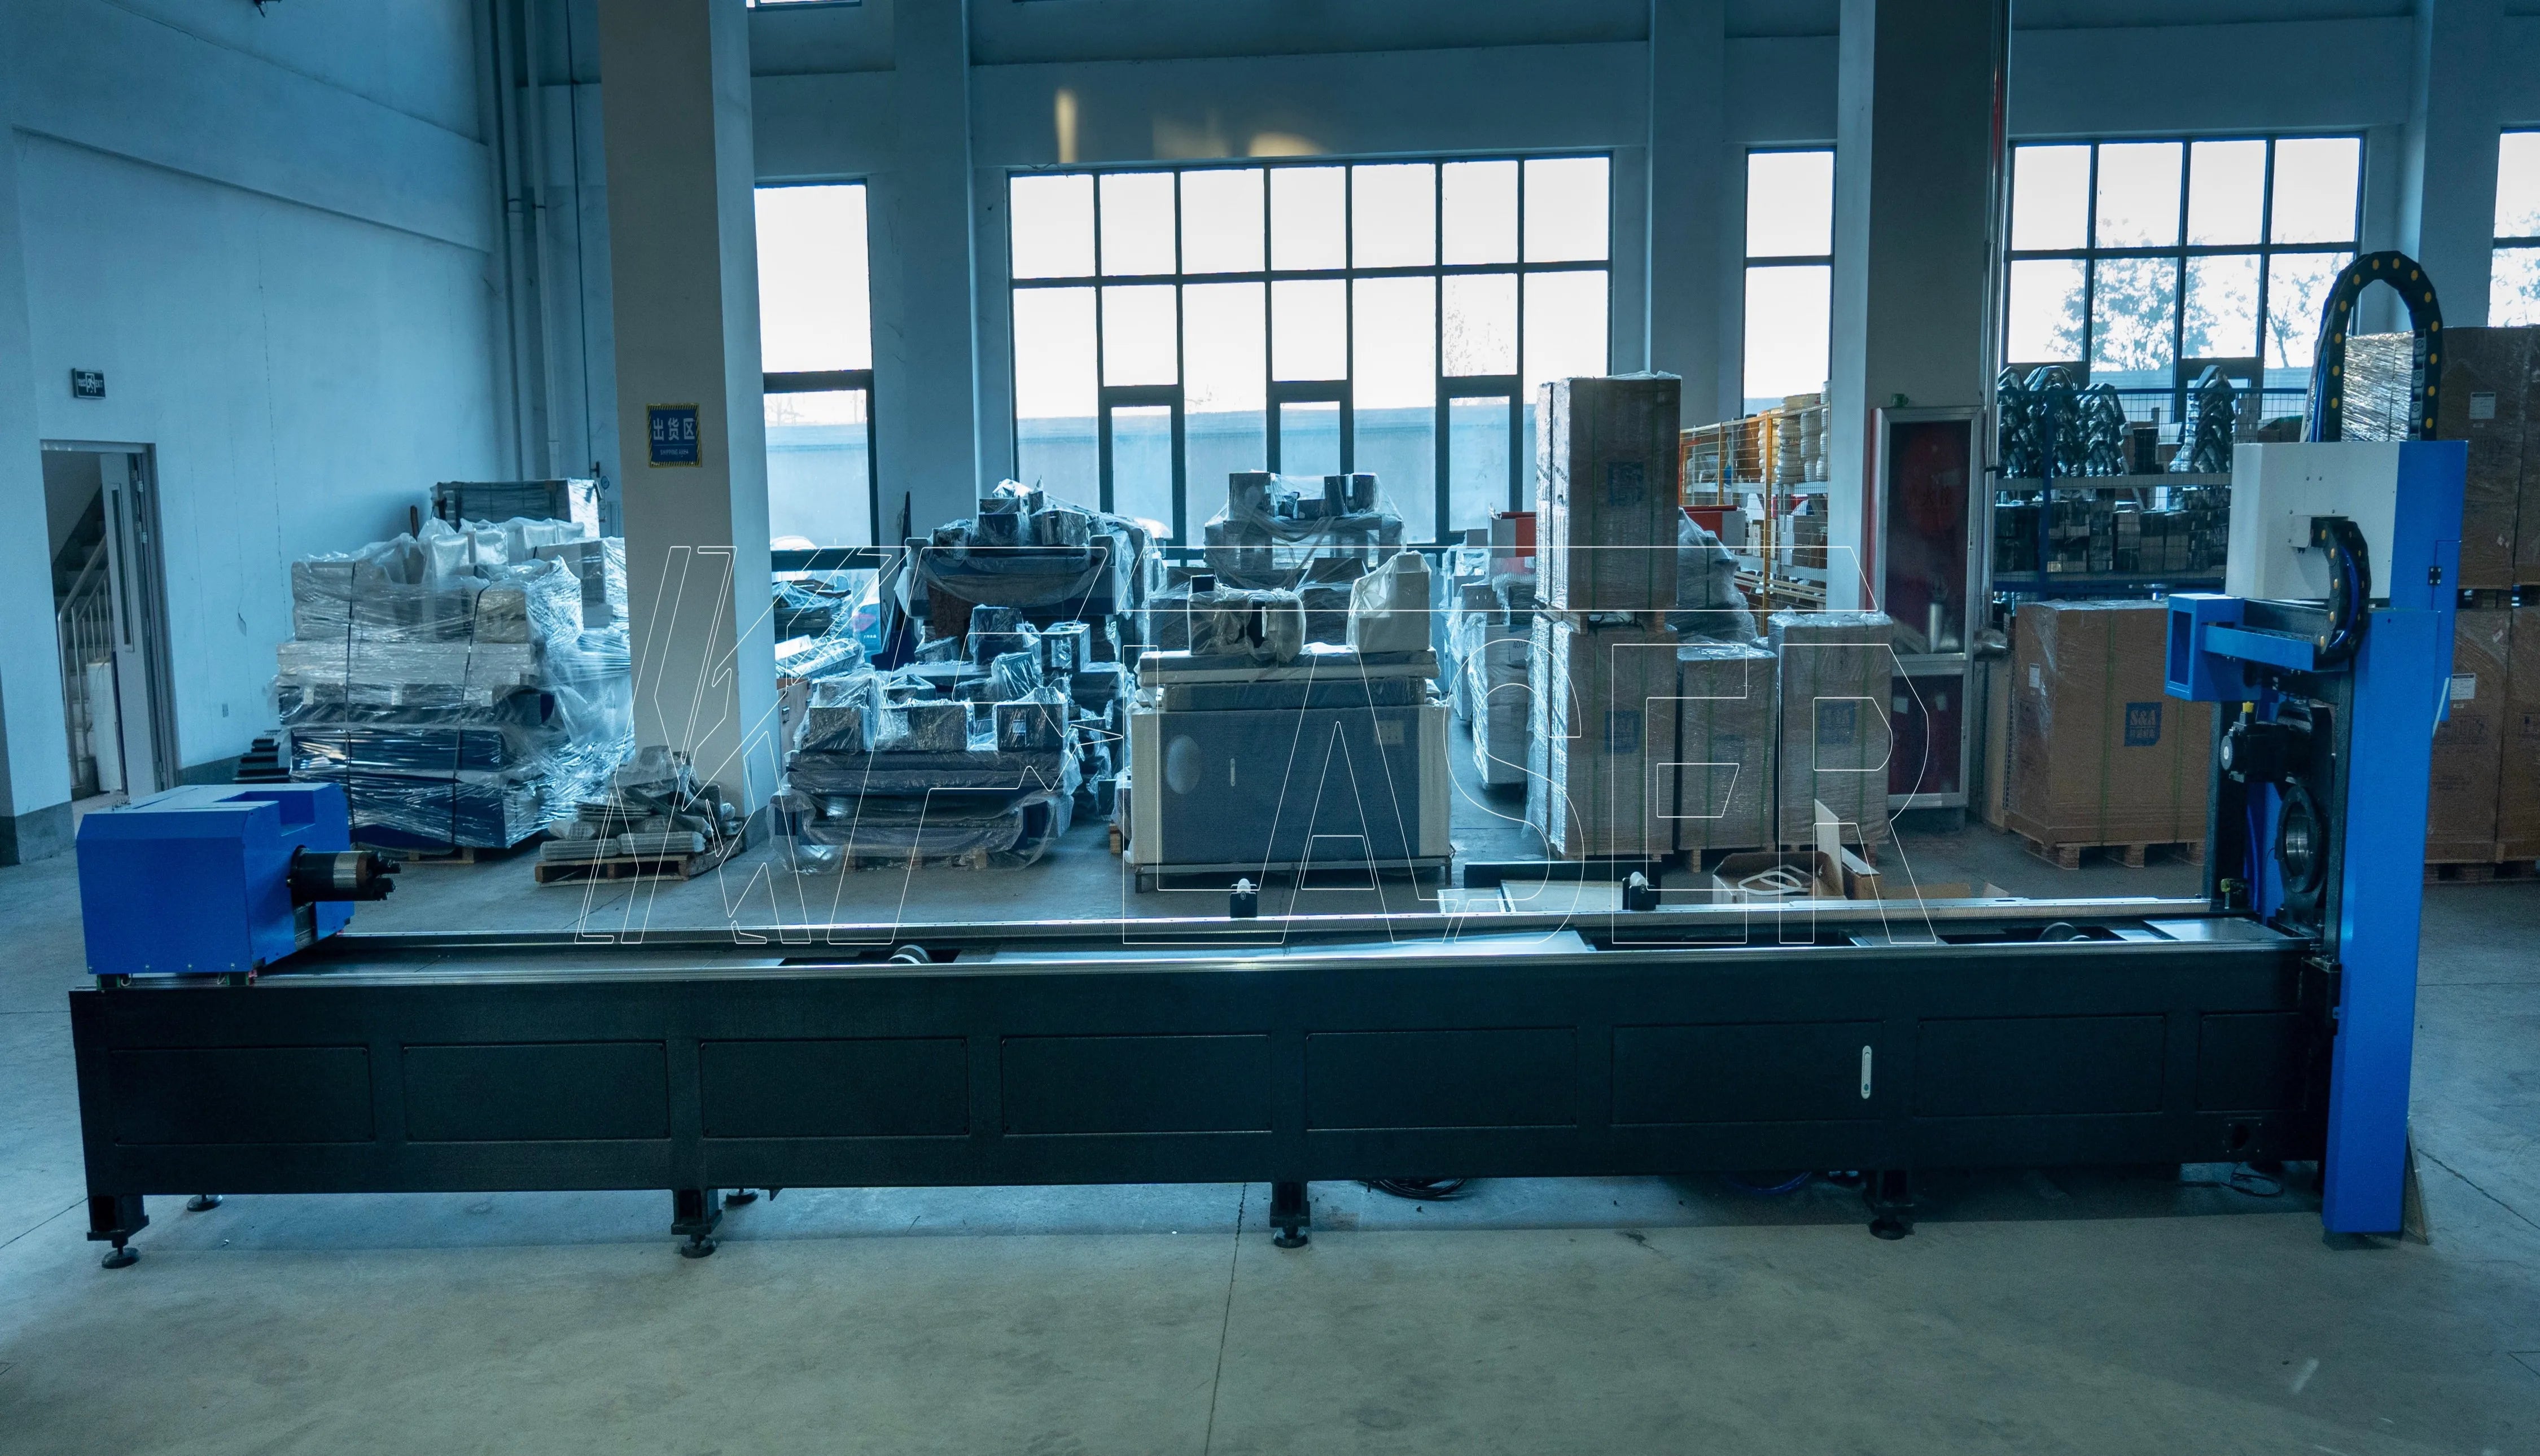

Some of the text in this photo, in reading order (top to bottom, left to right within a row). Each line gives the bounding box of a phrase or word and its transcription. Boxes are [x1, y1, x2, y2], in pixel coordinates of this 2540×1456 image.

[653, 418, 695, 441] 出货区
[2130, 709, 2156, 726] S&A
